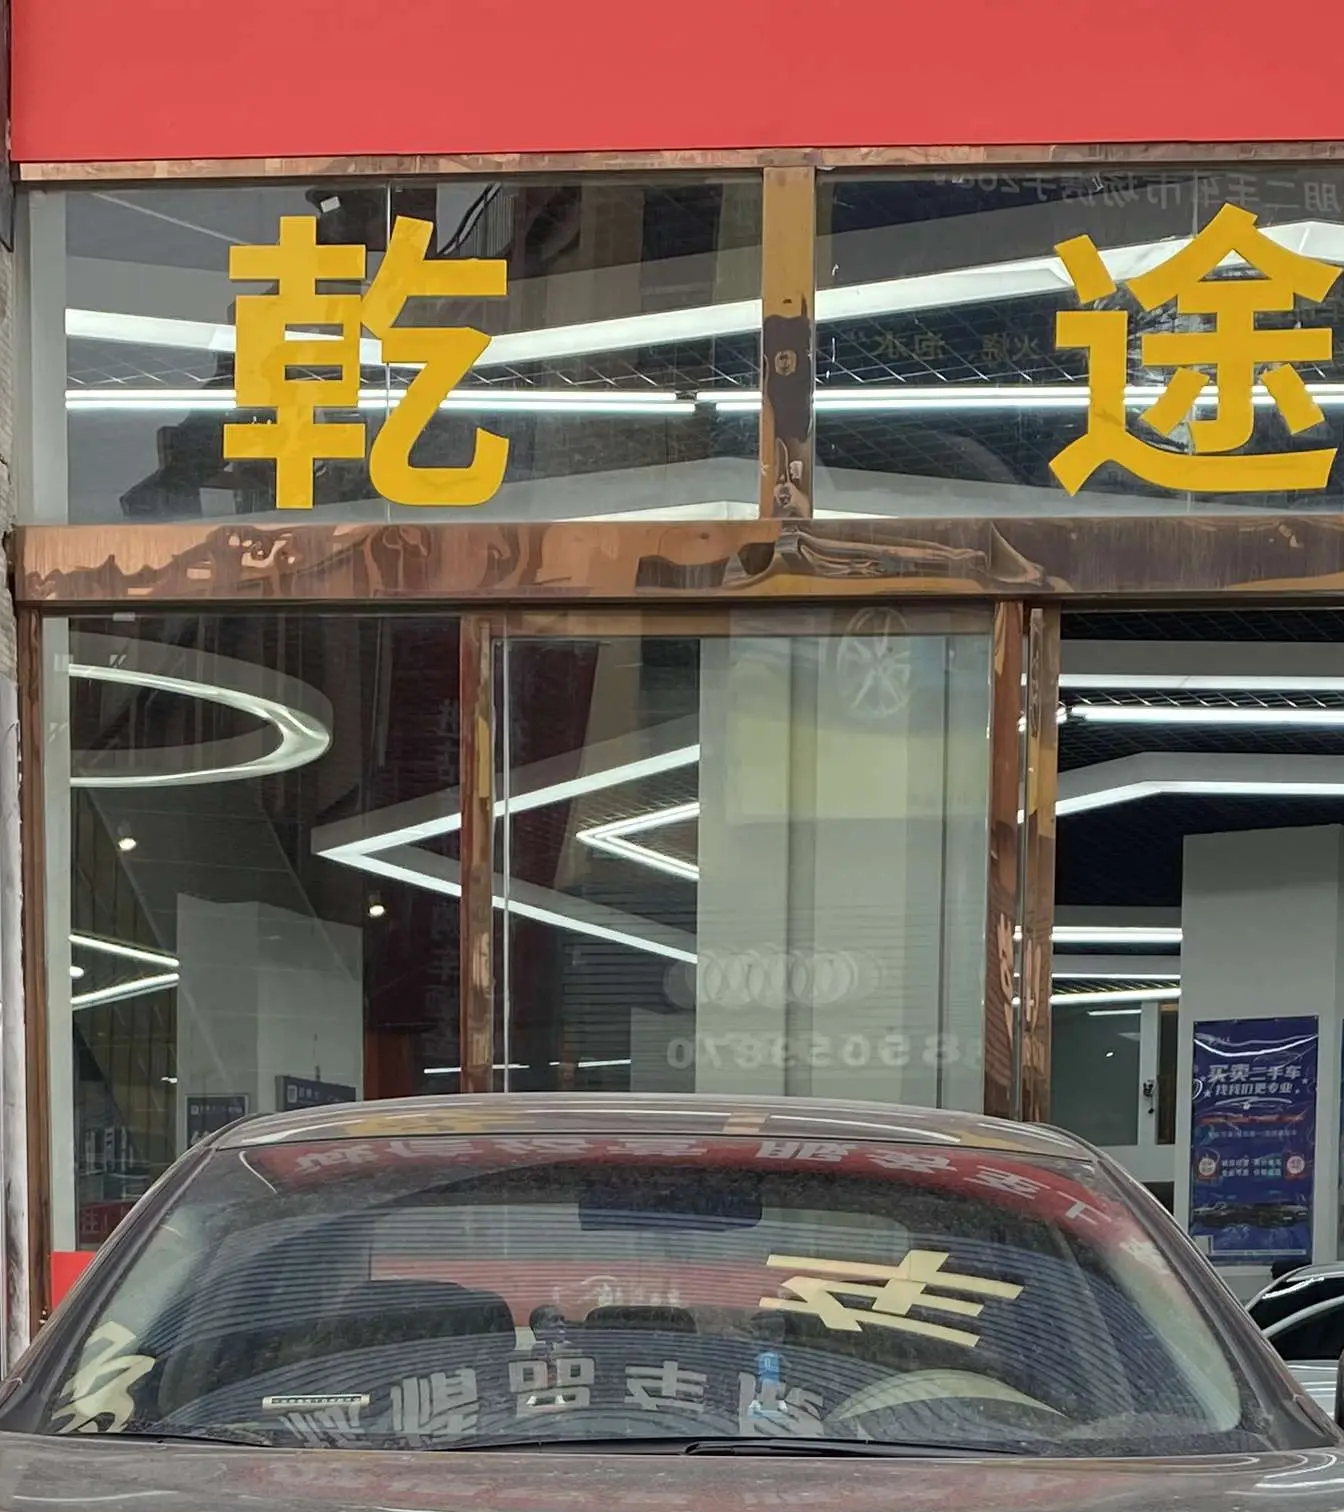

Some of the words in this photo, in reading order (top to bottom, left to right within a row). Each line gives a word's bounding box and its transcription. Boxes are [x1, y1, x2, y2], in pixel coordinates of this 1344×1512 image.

[222, 214, 509, 510] 乾
[1047, 202, 1344, 498] 途
[1208, 1063, 1302, 1083] 买卖二手车
[1215, 1082, 1293, 1096] 找我们更专业
